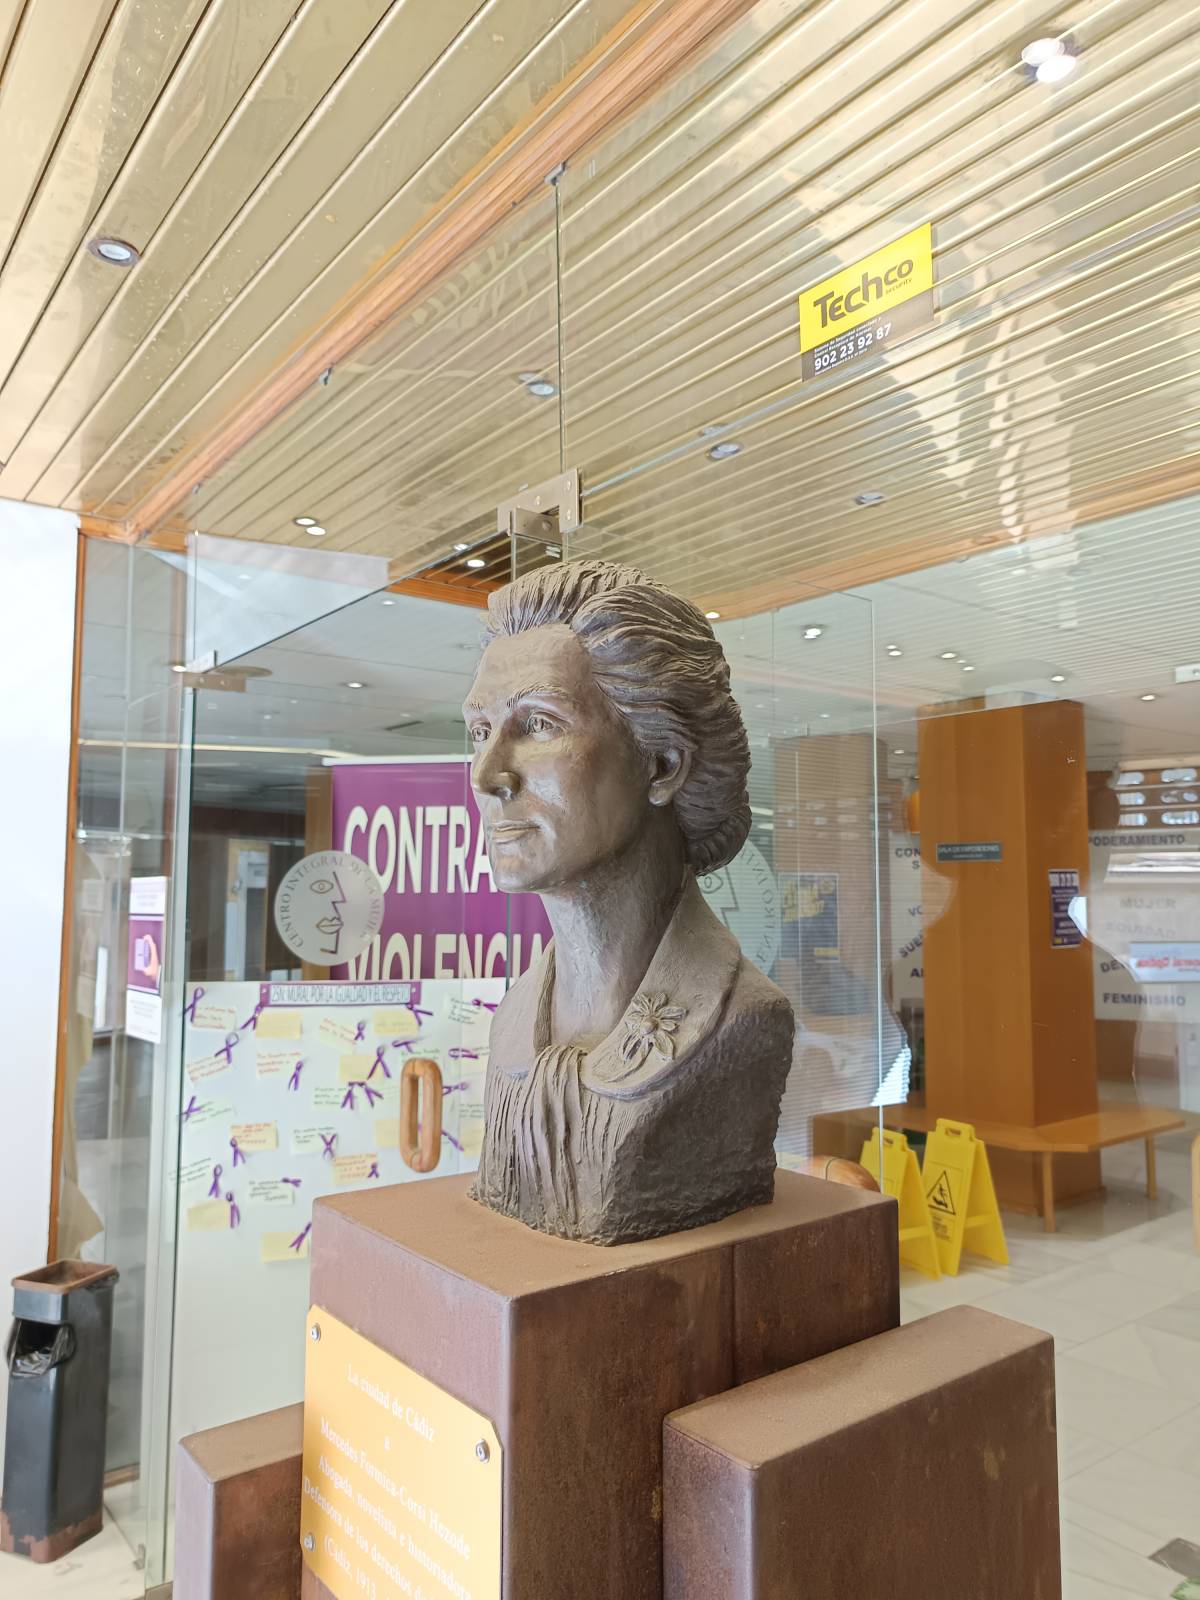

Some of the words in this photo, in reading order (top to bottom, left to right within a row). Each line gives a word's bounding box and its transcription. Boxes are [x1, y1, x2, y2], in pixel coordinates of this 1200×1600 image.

[813, 259, 914, 328] Techco
[814, 350, 837, 371] 902
[840, 341, 854, 358] 23
[857, 332, 873, 349] 92
[876, 322, 892, 340] 87
[286, 855, 343, 890] INTEGRAL
[343, 804, 499, 894] CONTRA
[280, 893, 304, 947] CENTRO
[1119, 897, 1177, 910] MUJER
[1102, 992, 1186, 1007] FEMINISMO
